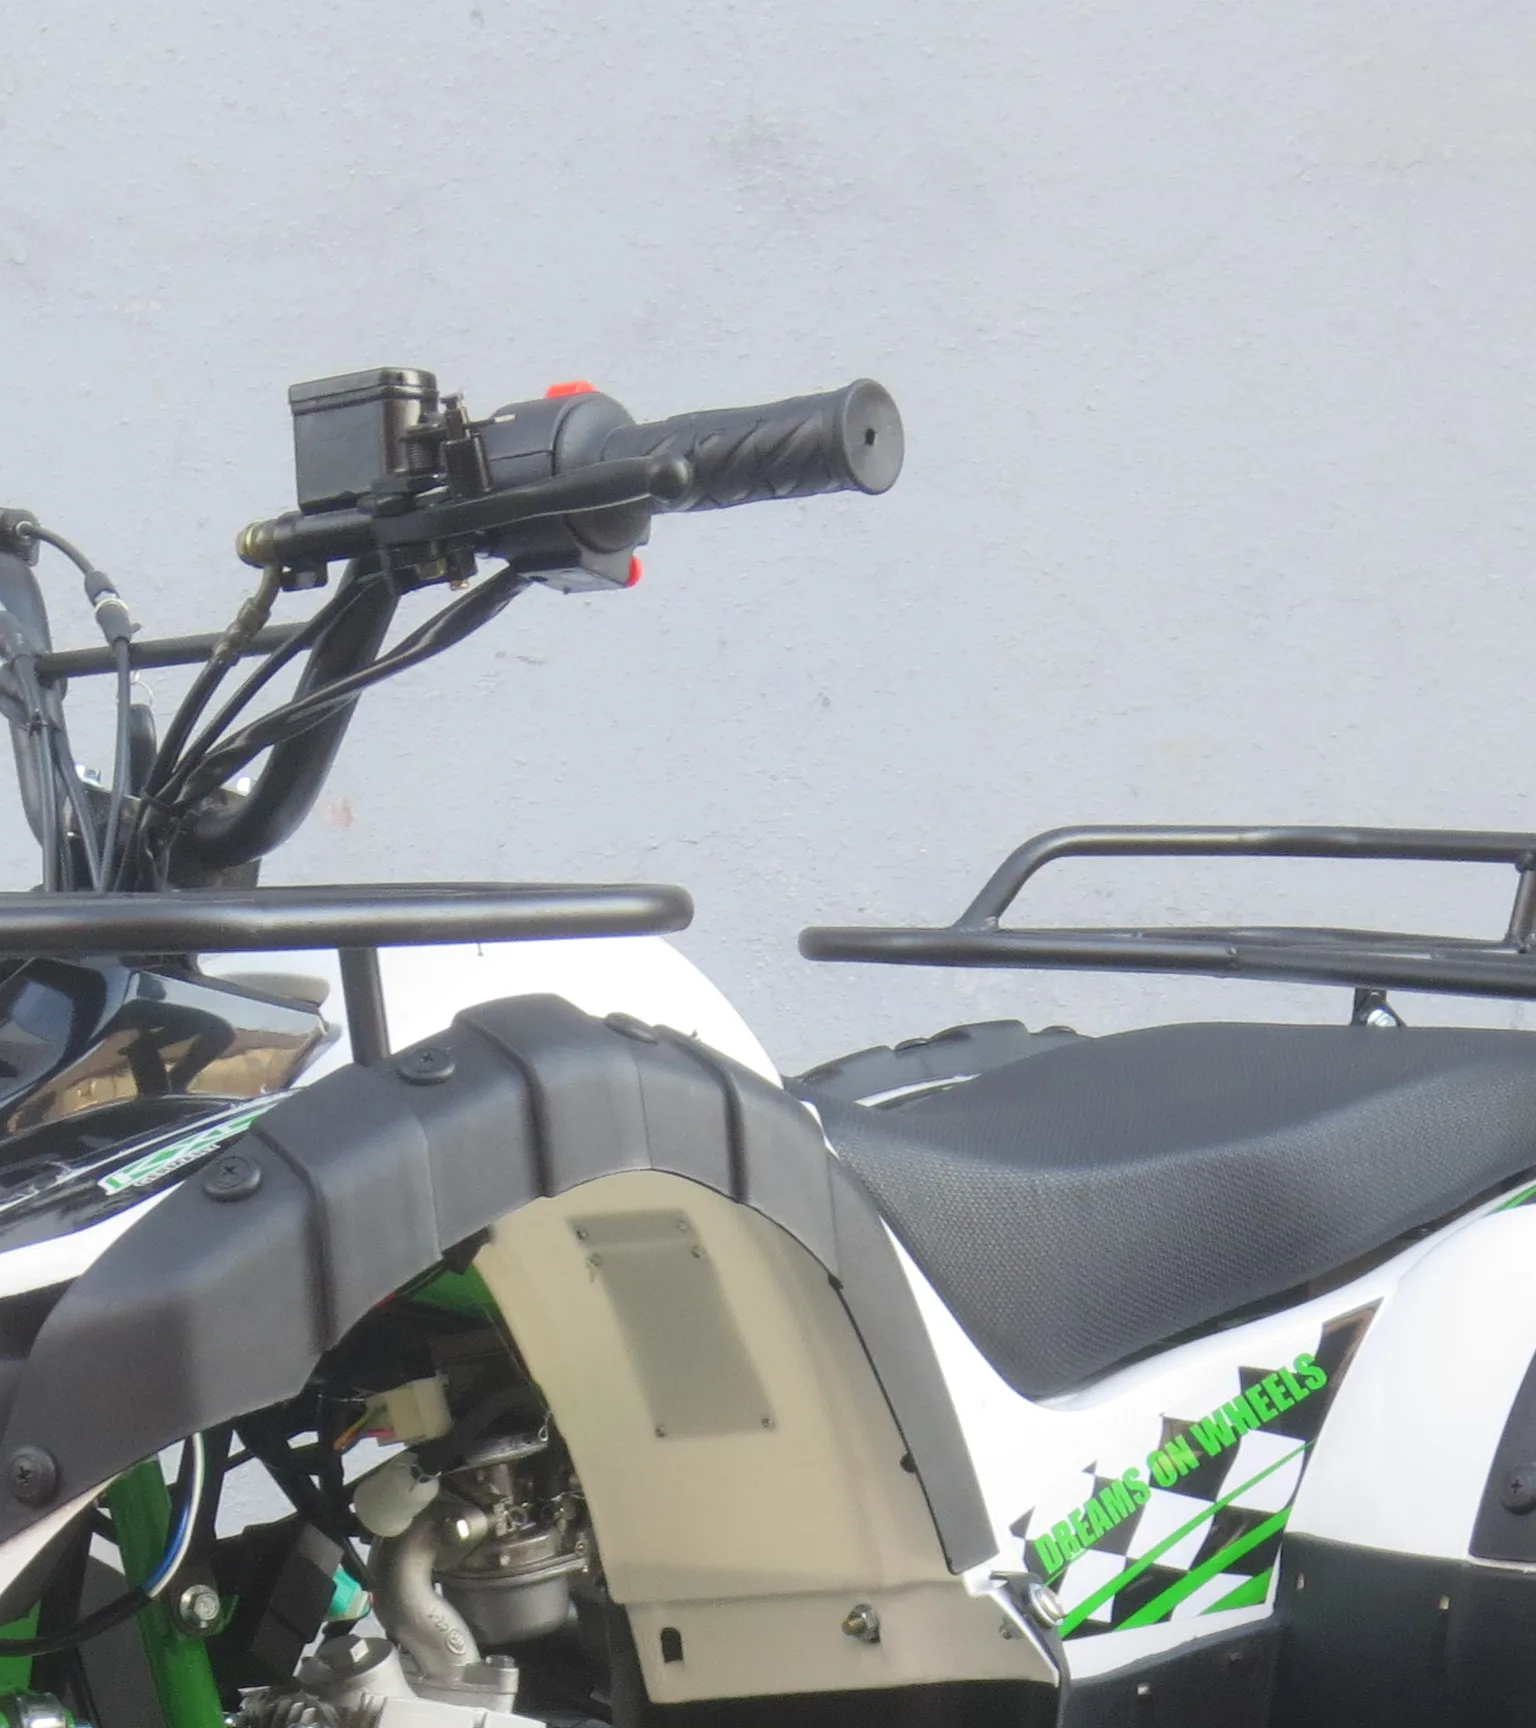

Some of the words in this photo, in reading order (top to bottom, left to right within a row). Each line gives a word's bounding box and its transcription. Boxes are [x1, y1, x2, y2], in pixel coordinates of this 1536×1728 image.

[1034, 1467, 1151, 1575] DREAMS
[1147, 1434, 1200, 1488] ON
[1191, 1352, 1328, 1458] WHEELS
